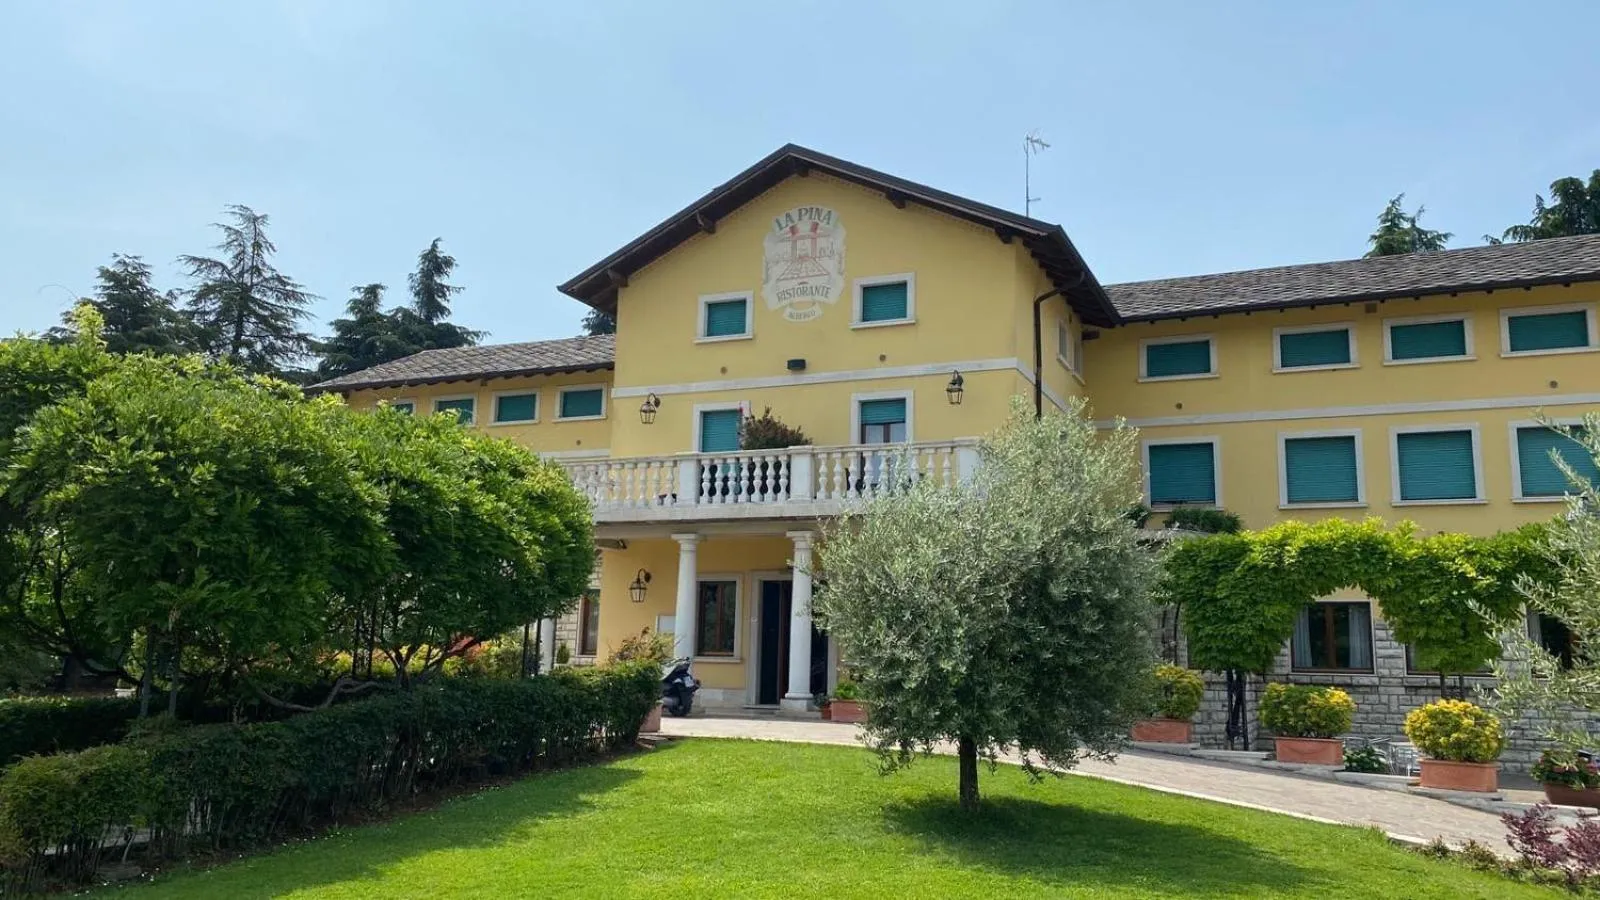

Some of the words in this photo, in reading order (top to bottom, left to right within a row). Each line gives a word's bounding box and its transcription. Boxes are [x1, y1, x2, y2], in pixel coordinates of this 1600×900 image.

[775, 212, 796, 231] LA
[798, 207, 832, 225] PINA
[776, 285, 831, 302] RISTORANTE
